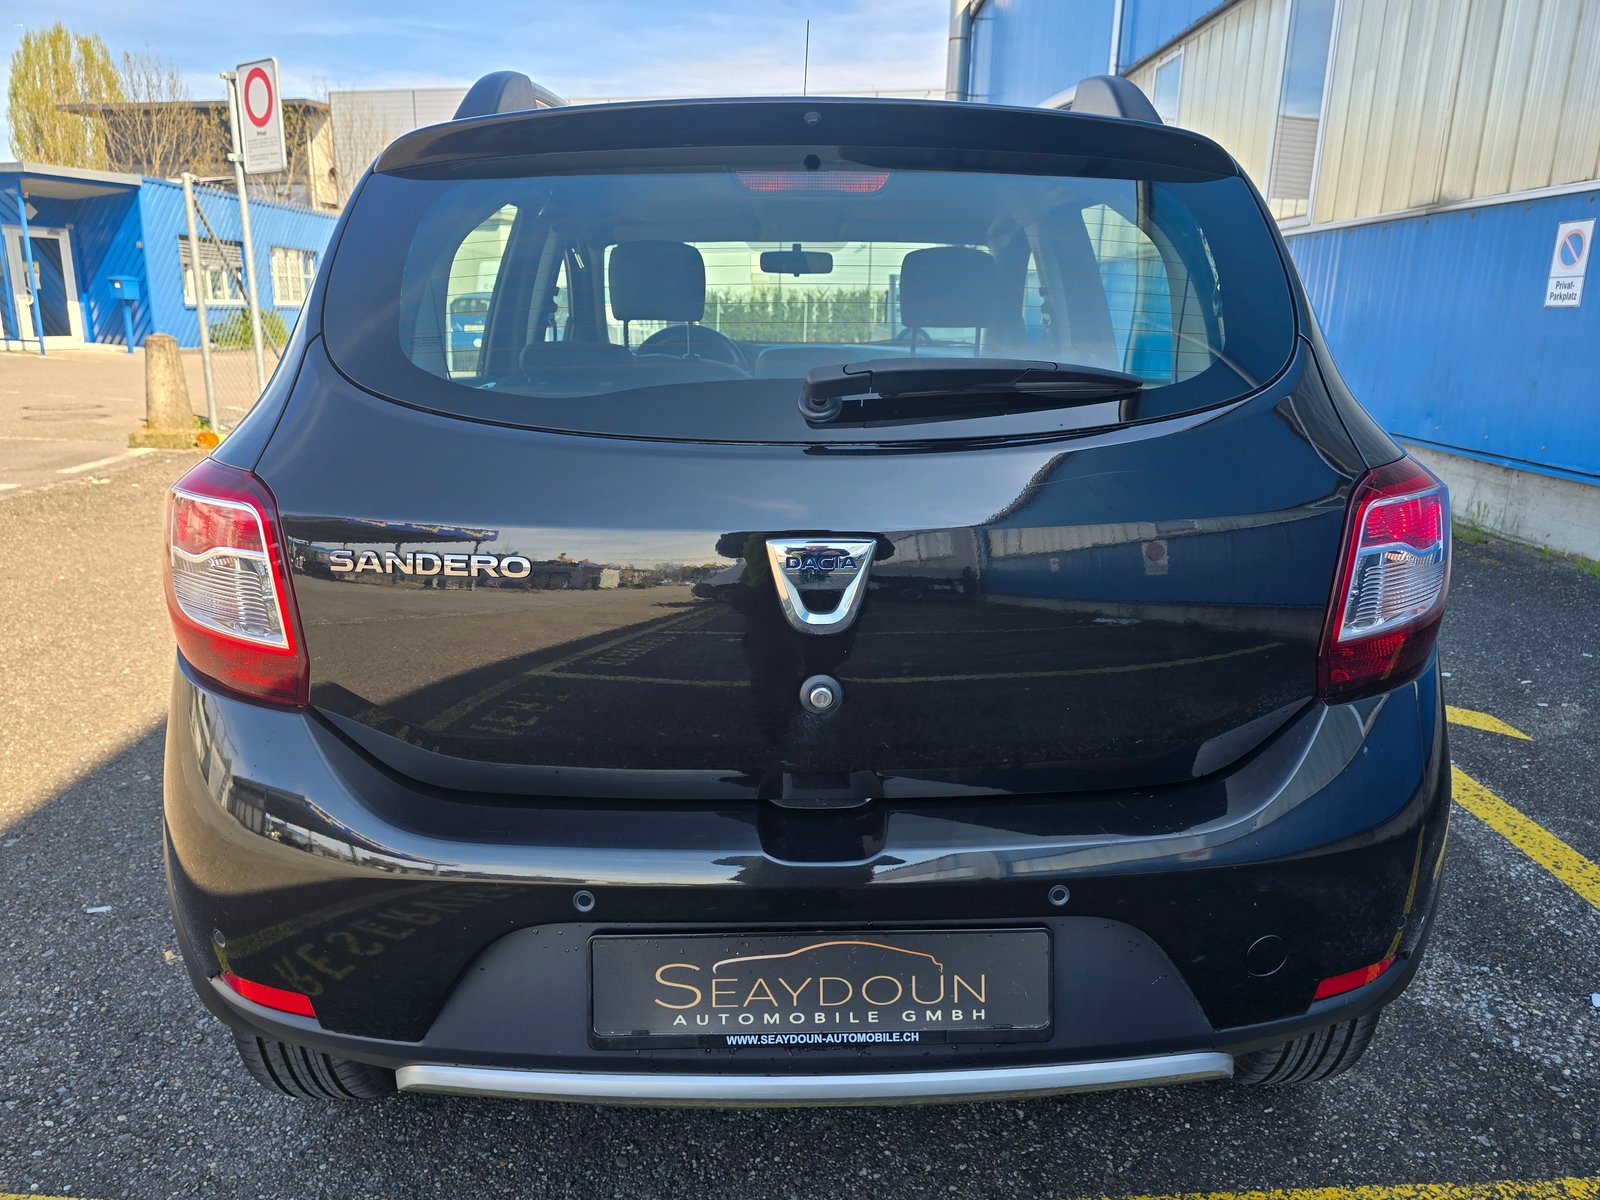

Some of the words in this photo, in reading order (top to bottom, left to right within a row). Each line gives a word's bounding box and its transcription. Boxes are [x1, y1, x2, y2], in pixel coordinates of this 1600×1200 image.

[1555, 281, 1575, 290] Privat-
[1549, 292, 1577, 302] Parkplatz
[329, 550, 533, 579] SANDERO
[786, 557, 857, 570] DACIA
[673, 1011, 879, 1026] AUTOMOBILE
[902, 1009, 986, 1022] GMBH
[726, 1032, 920, 1045] WWW.SEAYDOUN-AUTOMOBILE.CH
